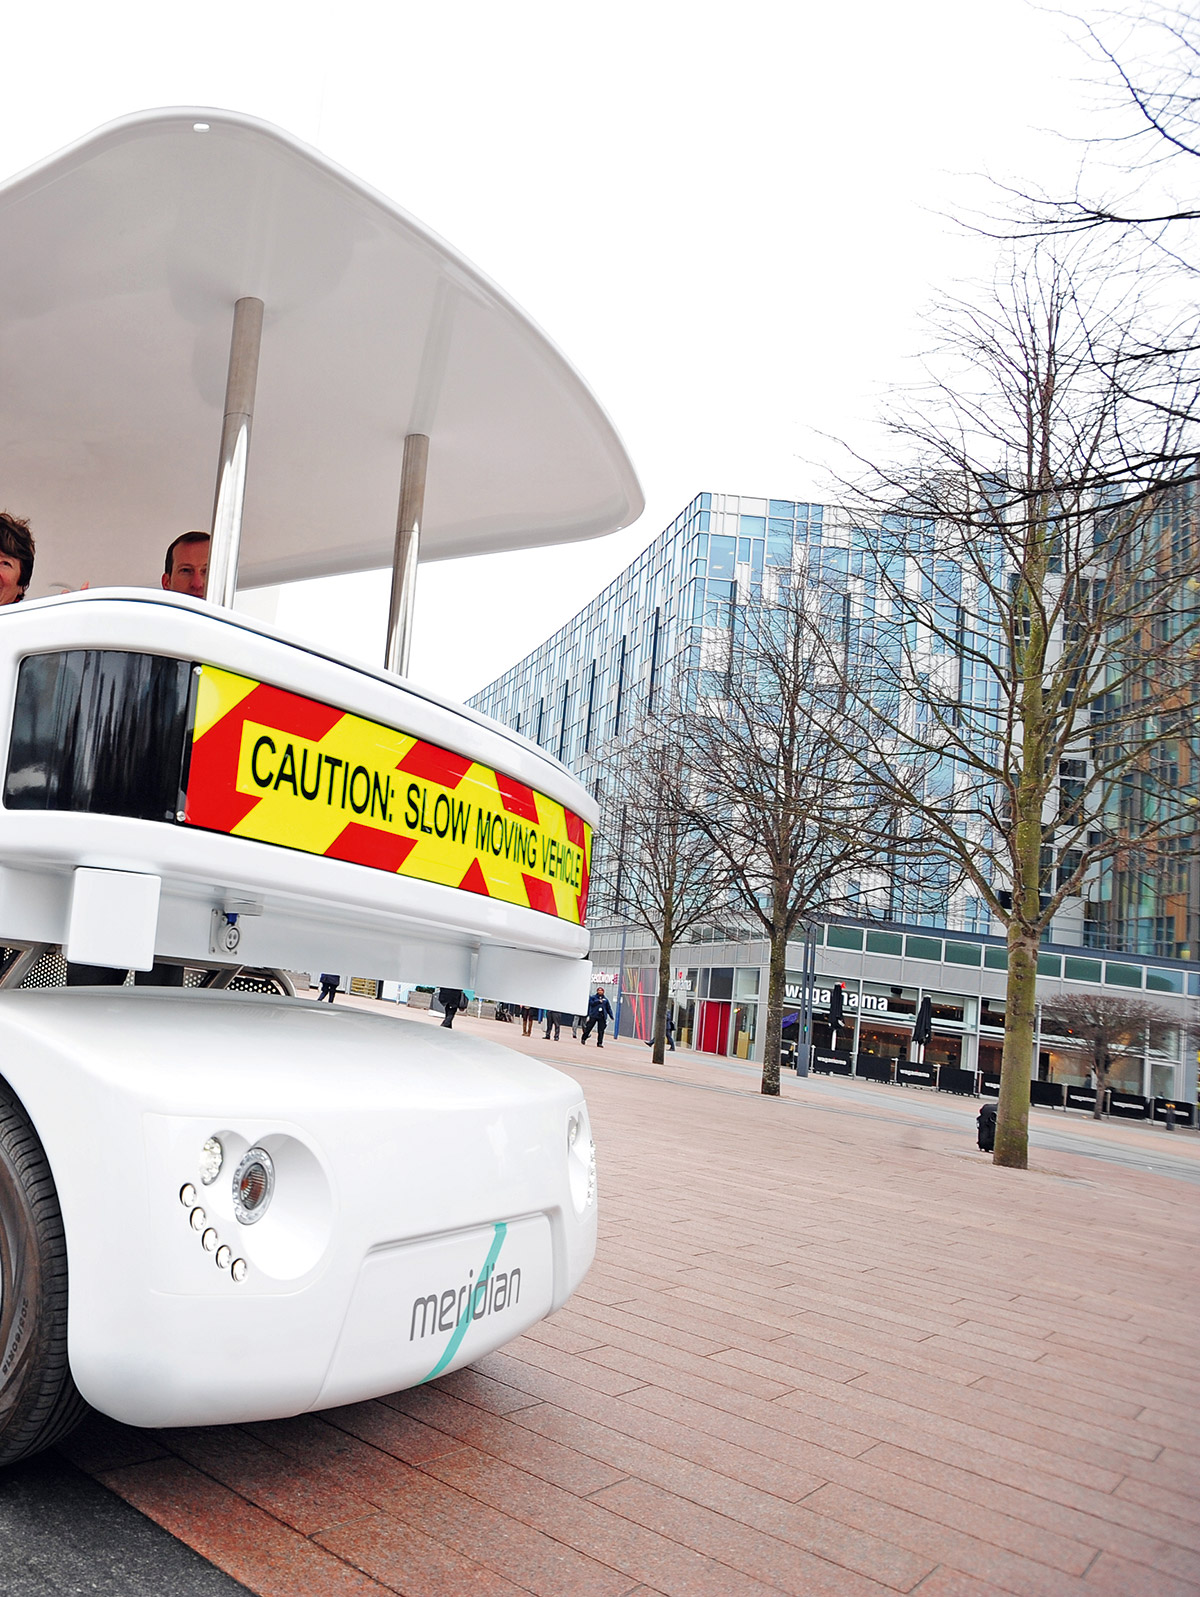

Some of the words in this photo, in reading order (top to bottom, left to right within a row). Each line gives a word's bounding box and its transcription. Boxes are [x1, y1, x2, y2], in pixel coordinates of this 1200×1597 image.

[251, 735, 395, 823] CAUTION:
[404, 783, 471, 845] SLOW
[475, 807, 538, 869] MOVING
[542, 834, 582, 889] VEHICLE
[409, 1263, 521, 1341] meridian
